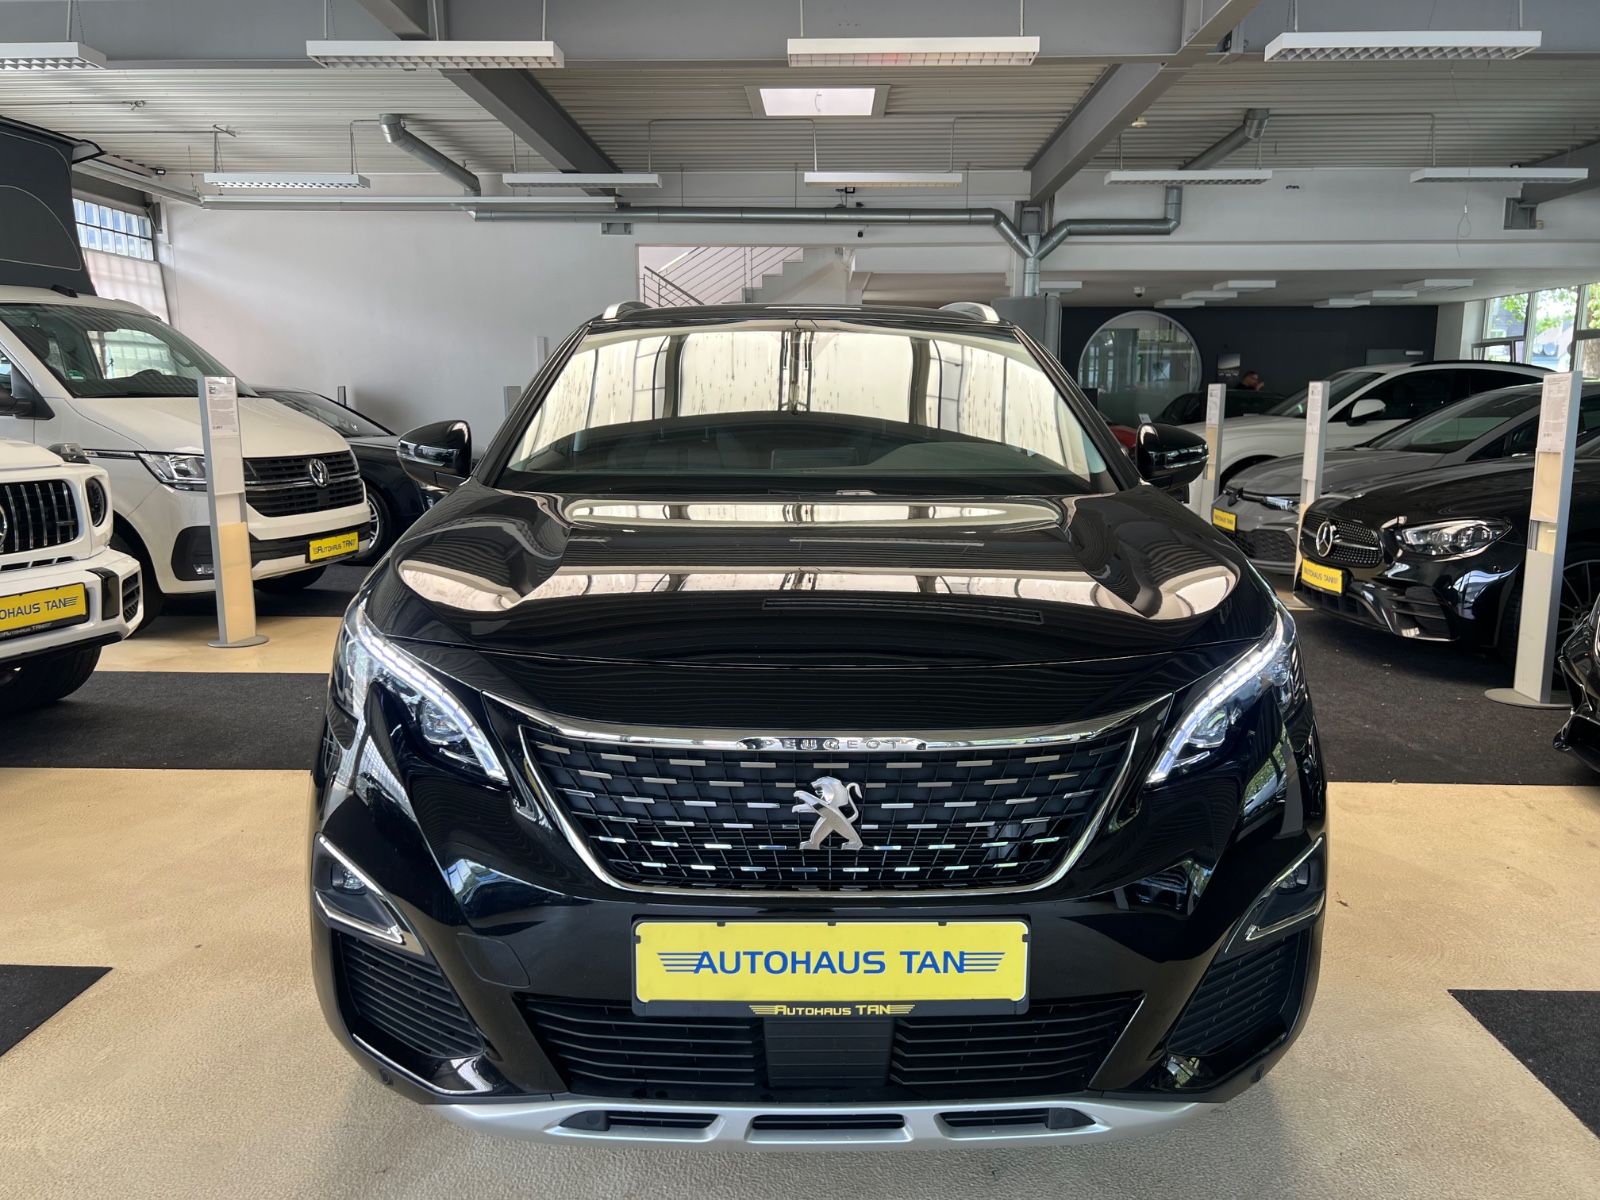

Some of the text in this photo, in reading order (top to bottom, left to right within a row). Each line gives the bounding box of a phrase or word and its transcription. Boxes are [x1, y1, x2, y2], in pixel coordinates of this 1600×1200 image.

[44, 598, 66, 611] TAN
[762, 737, 897, 750] PEUGEOT
[693, 950, 965, 975] AUTOHAUS TAN
[774, 1004, 891, 1016] AUTOHAUS TAN
